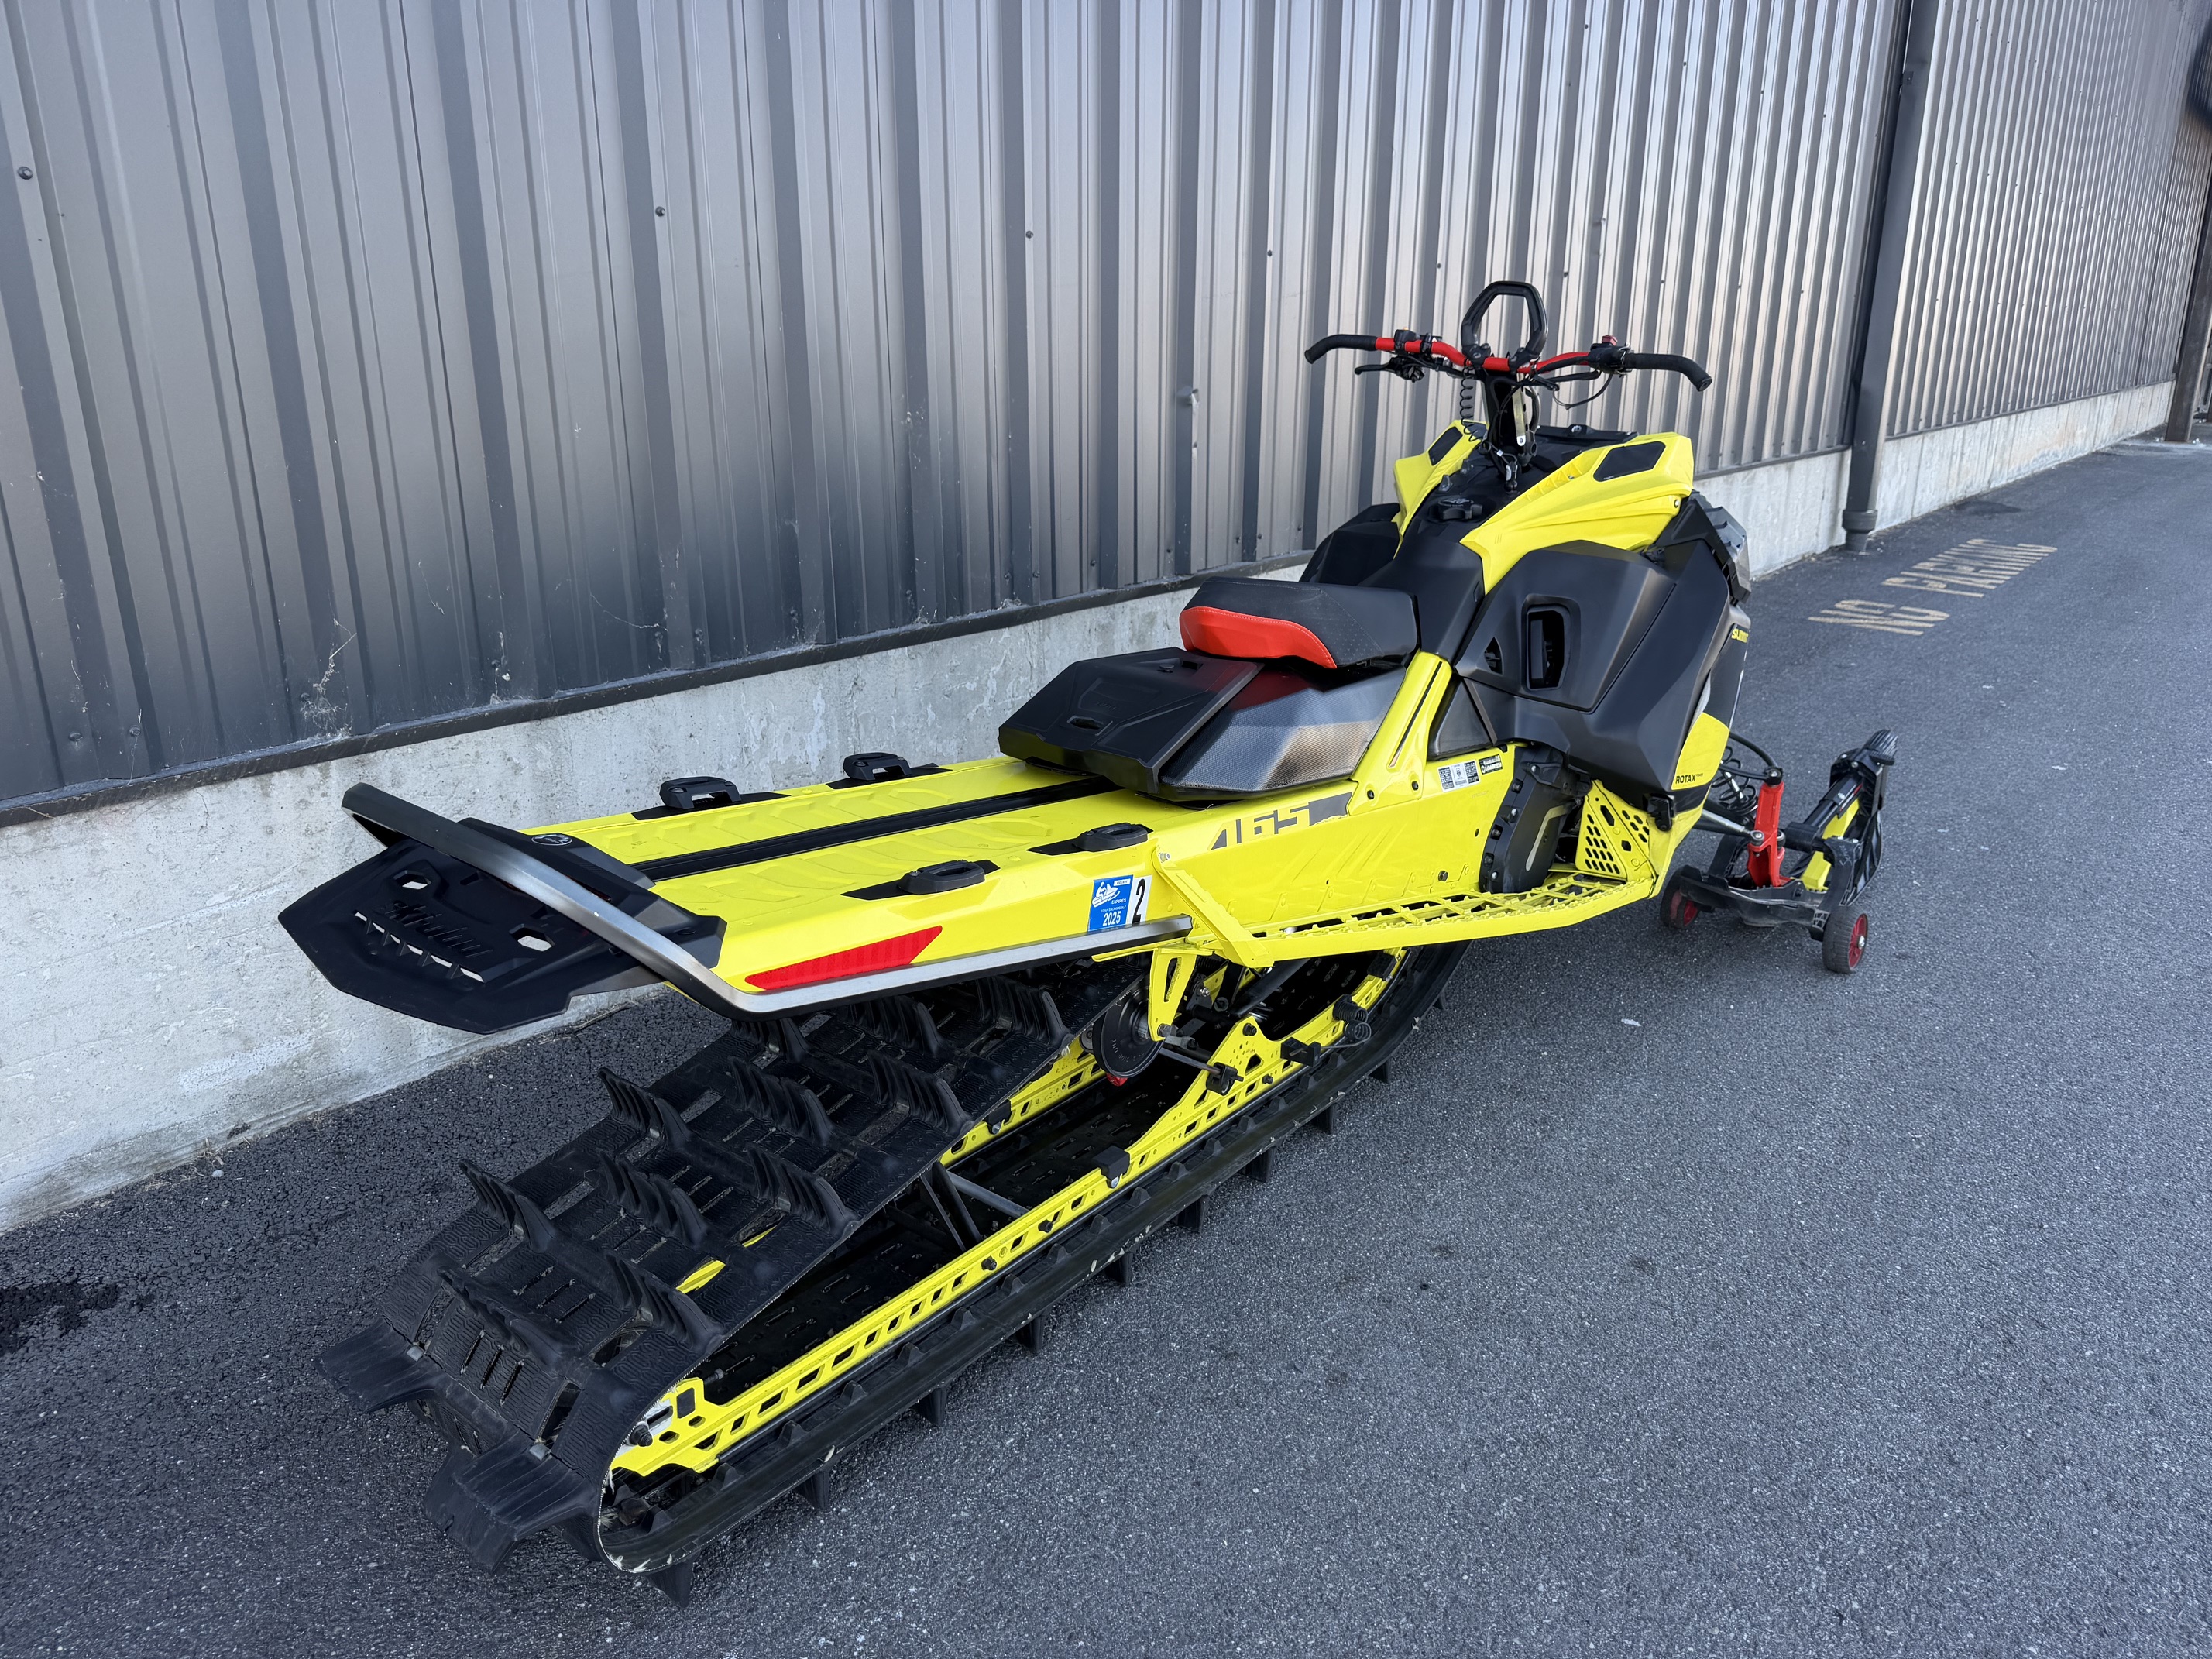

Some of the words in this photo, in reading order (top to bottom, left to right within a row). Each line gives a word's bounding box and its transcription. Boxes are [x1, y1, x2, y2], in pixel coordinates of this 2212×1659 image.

[1882, 539, 2058, 598] PARKING
[1675, 774, 1696, 784] ROTAX
[1132, 878, 1146, 925] 2
[1102, 911, 1122, 926] 2025
